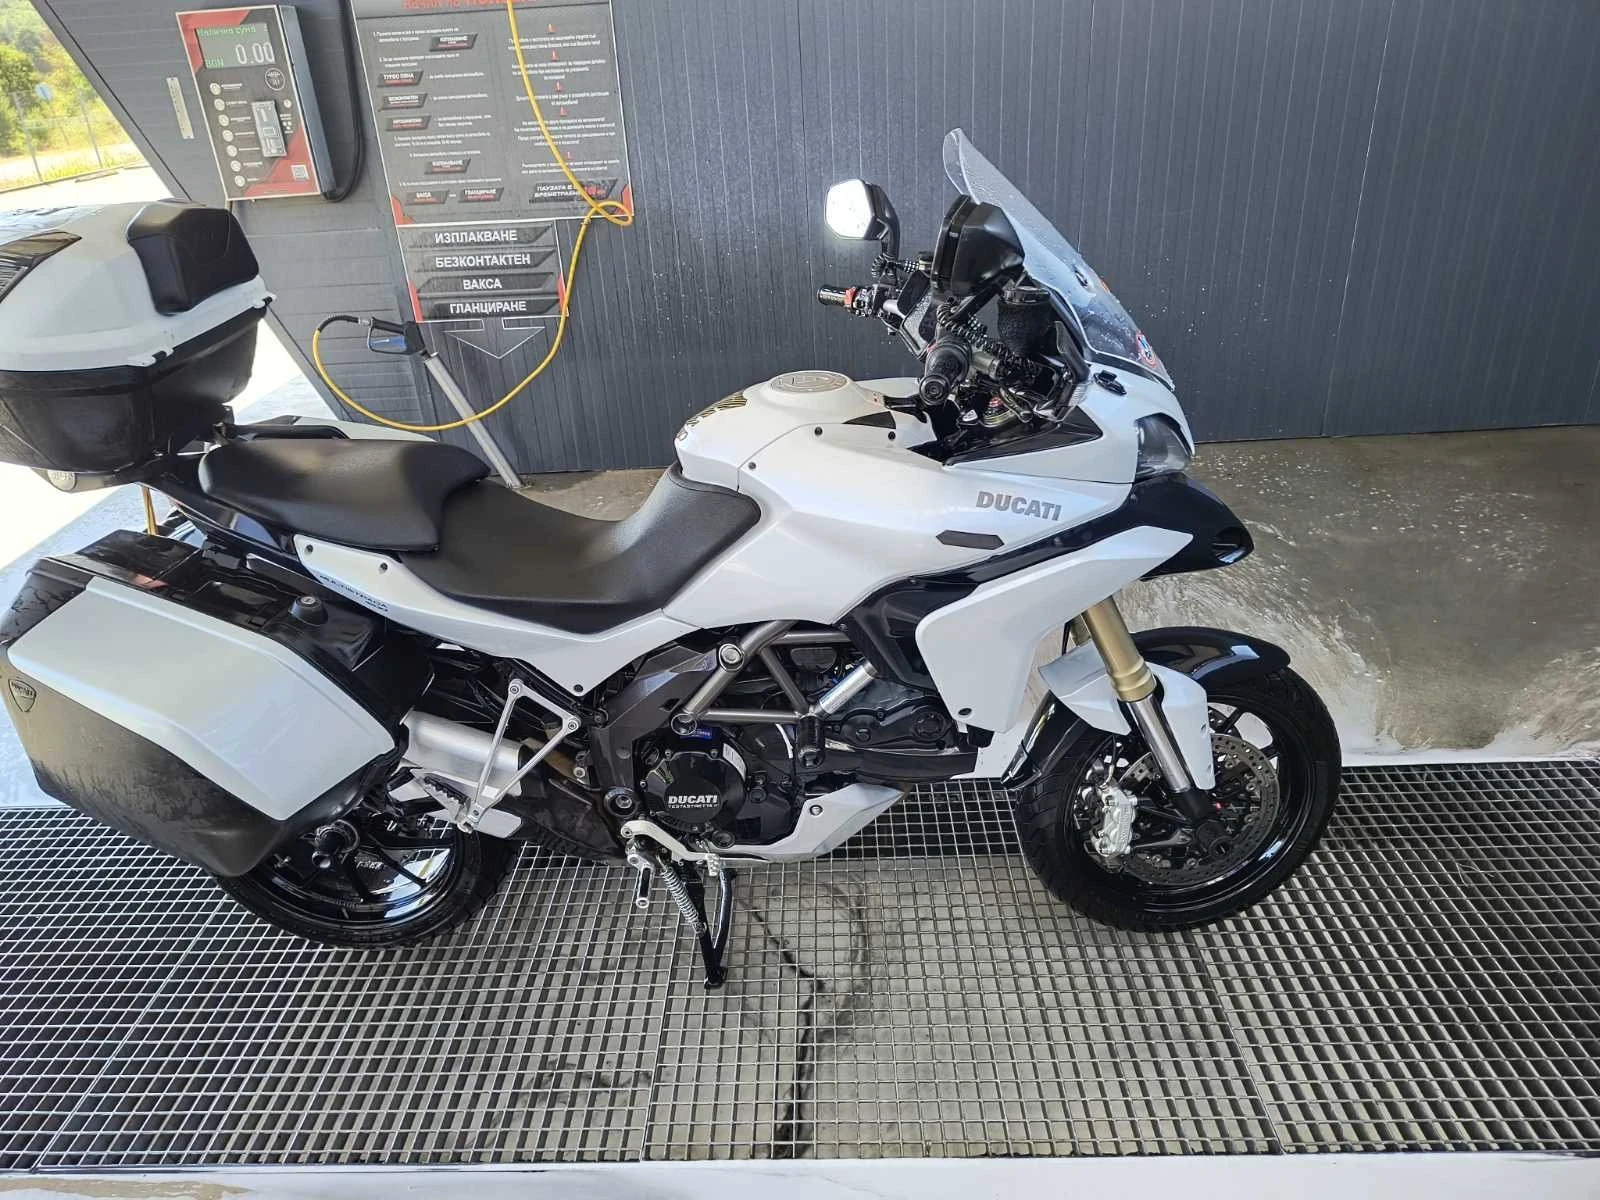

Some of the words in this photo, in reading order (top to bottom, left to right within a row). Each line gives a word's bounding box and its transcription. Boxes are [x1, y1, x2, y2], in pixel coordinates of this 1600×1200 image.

[235, 41, 275, 65] 0.00
[434, 229, 518, 244] ИЗПЛАКВАНЕ
[435, 253, 531, 268] БЕЗКОНТАКТЕН
[463, 278, 503, 290] ВАКСА
[450, 300, 527, 314] ГЛАНЦИРАНЕ
[976, 491, 1062, 521] DUCATI
[668, 794, 718, 804] DUCATI
